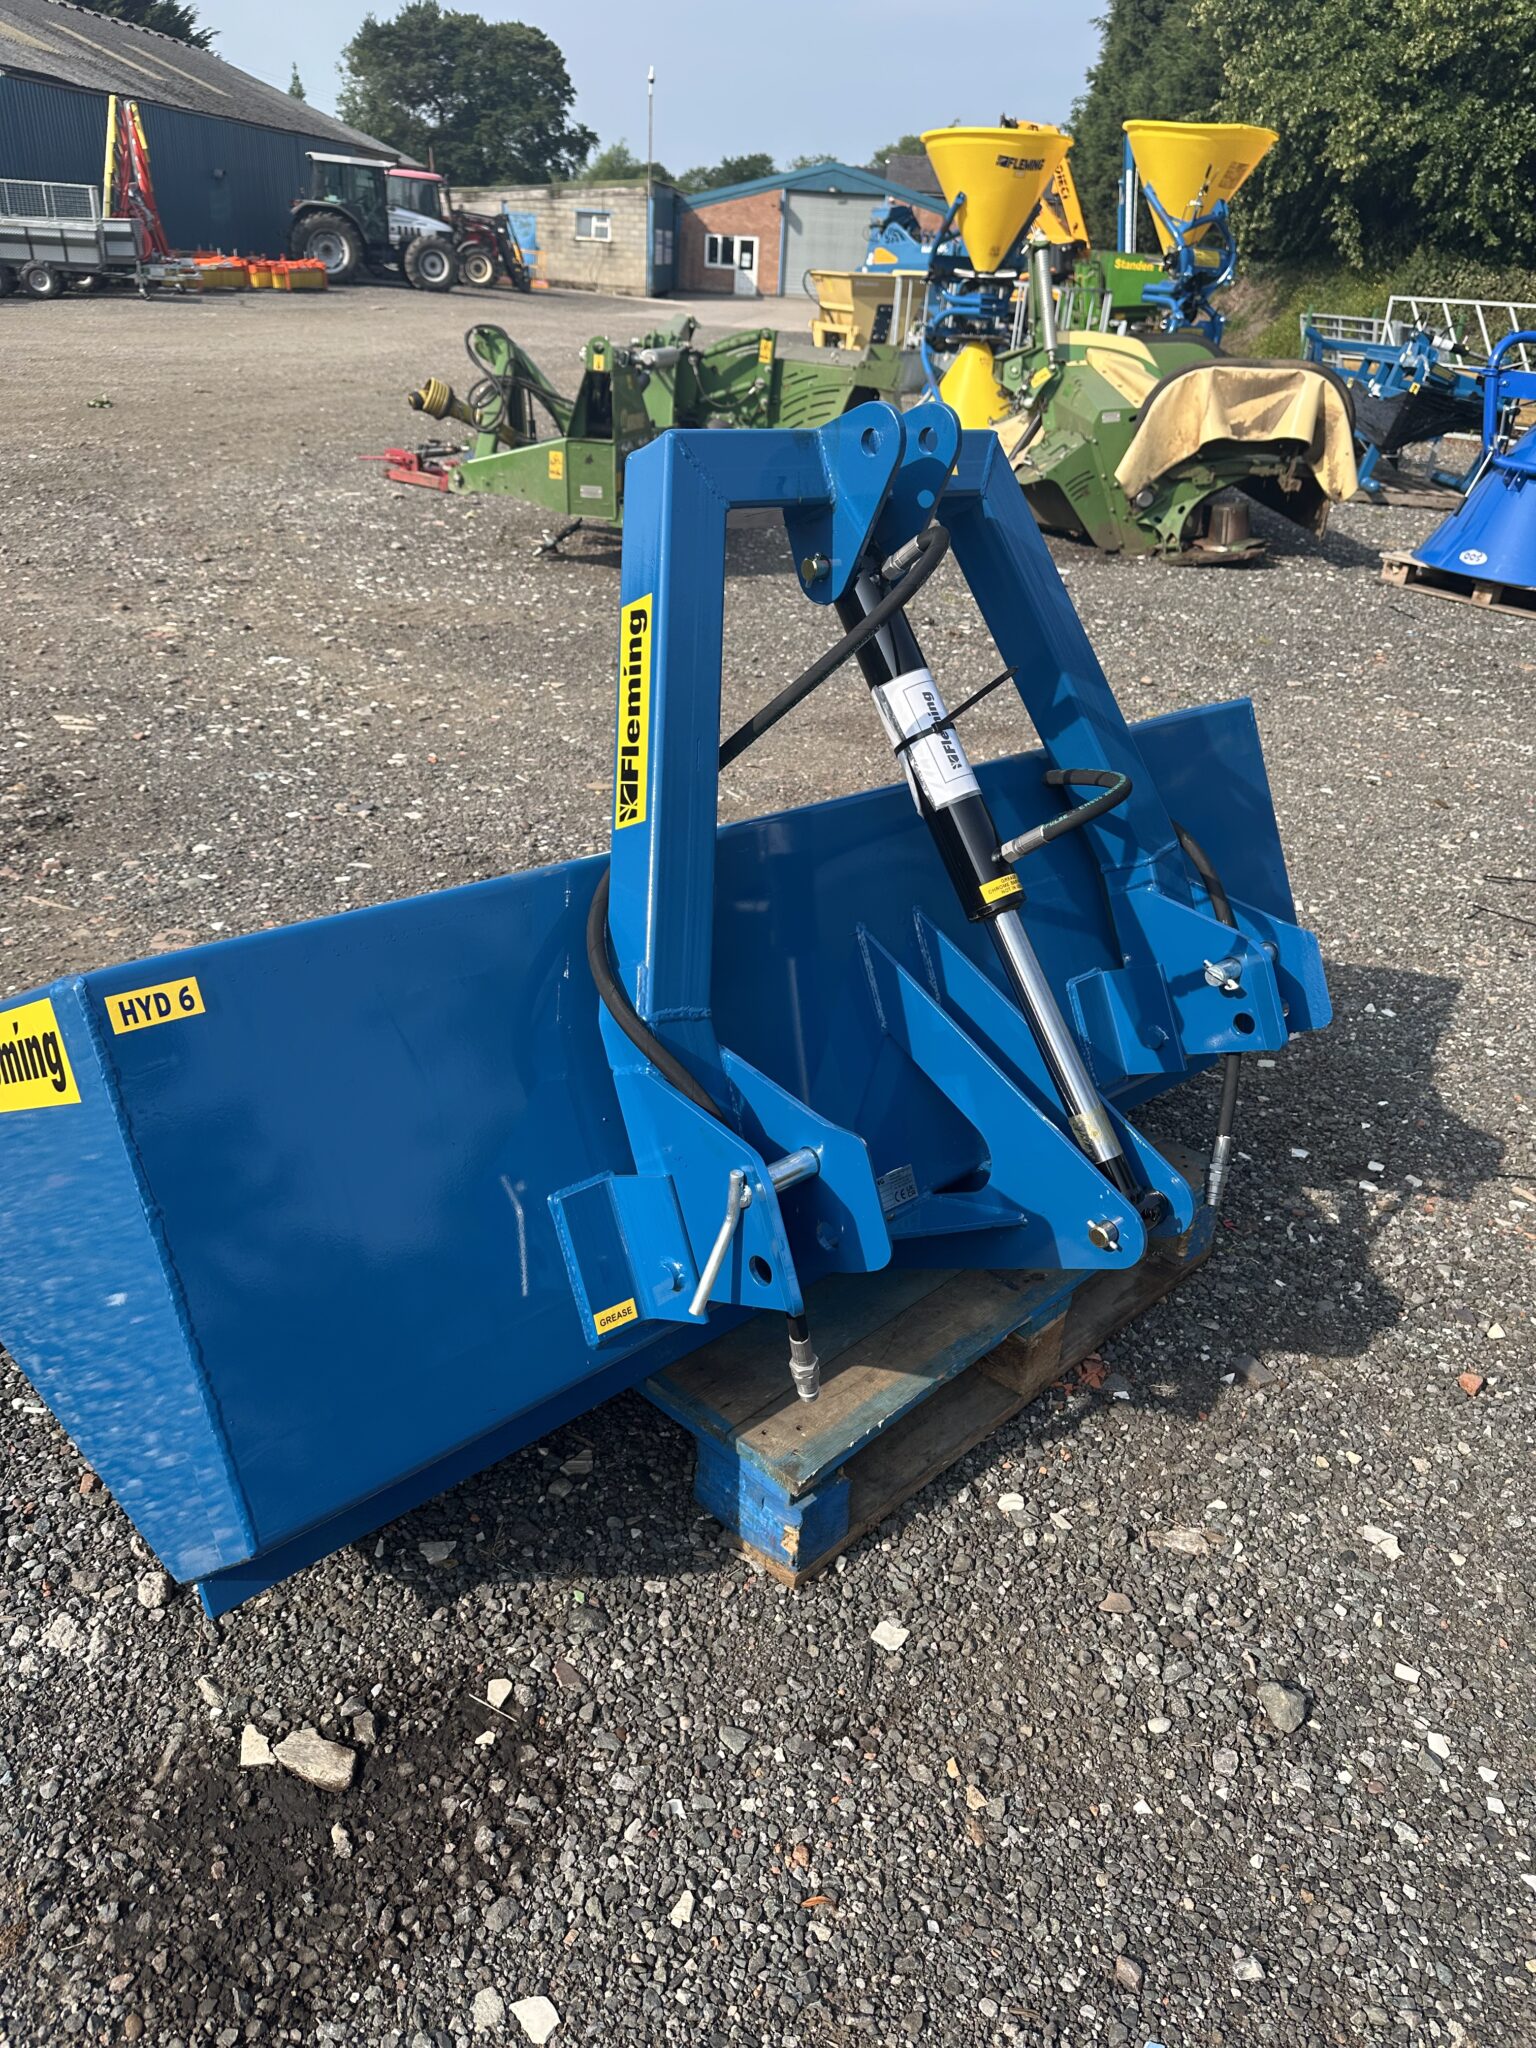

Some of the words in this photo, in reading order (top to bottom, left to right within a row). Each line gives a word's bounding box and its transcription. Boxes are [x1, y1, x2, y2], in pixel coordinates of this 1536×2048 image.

[1007, 157, 1046, 171] FLEMING
[1114, 257, 1154, 272] Standen
[620, 608, 648, 782] Fleming
[117, 992, 172, 1027] HYD
[178, 985, 196, 1013] 6
[0, 1020, 67, 1093] ming
[599, 1306, 634, 1328] GREASE
